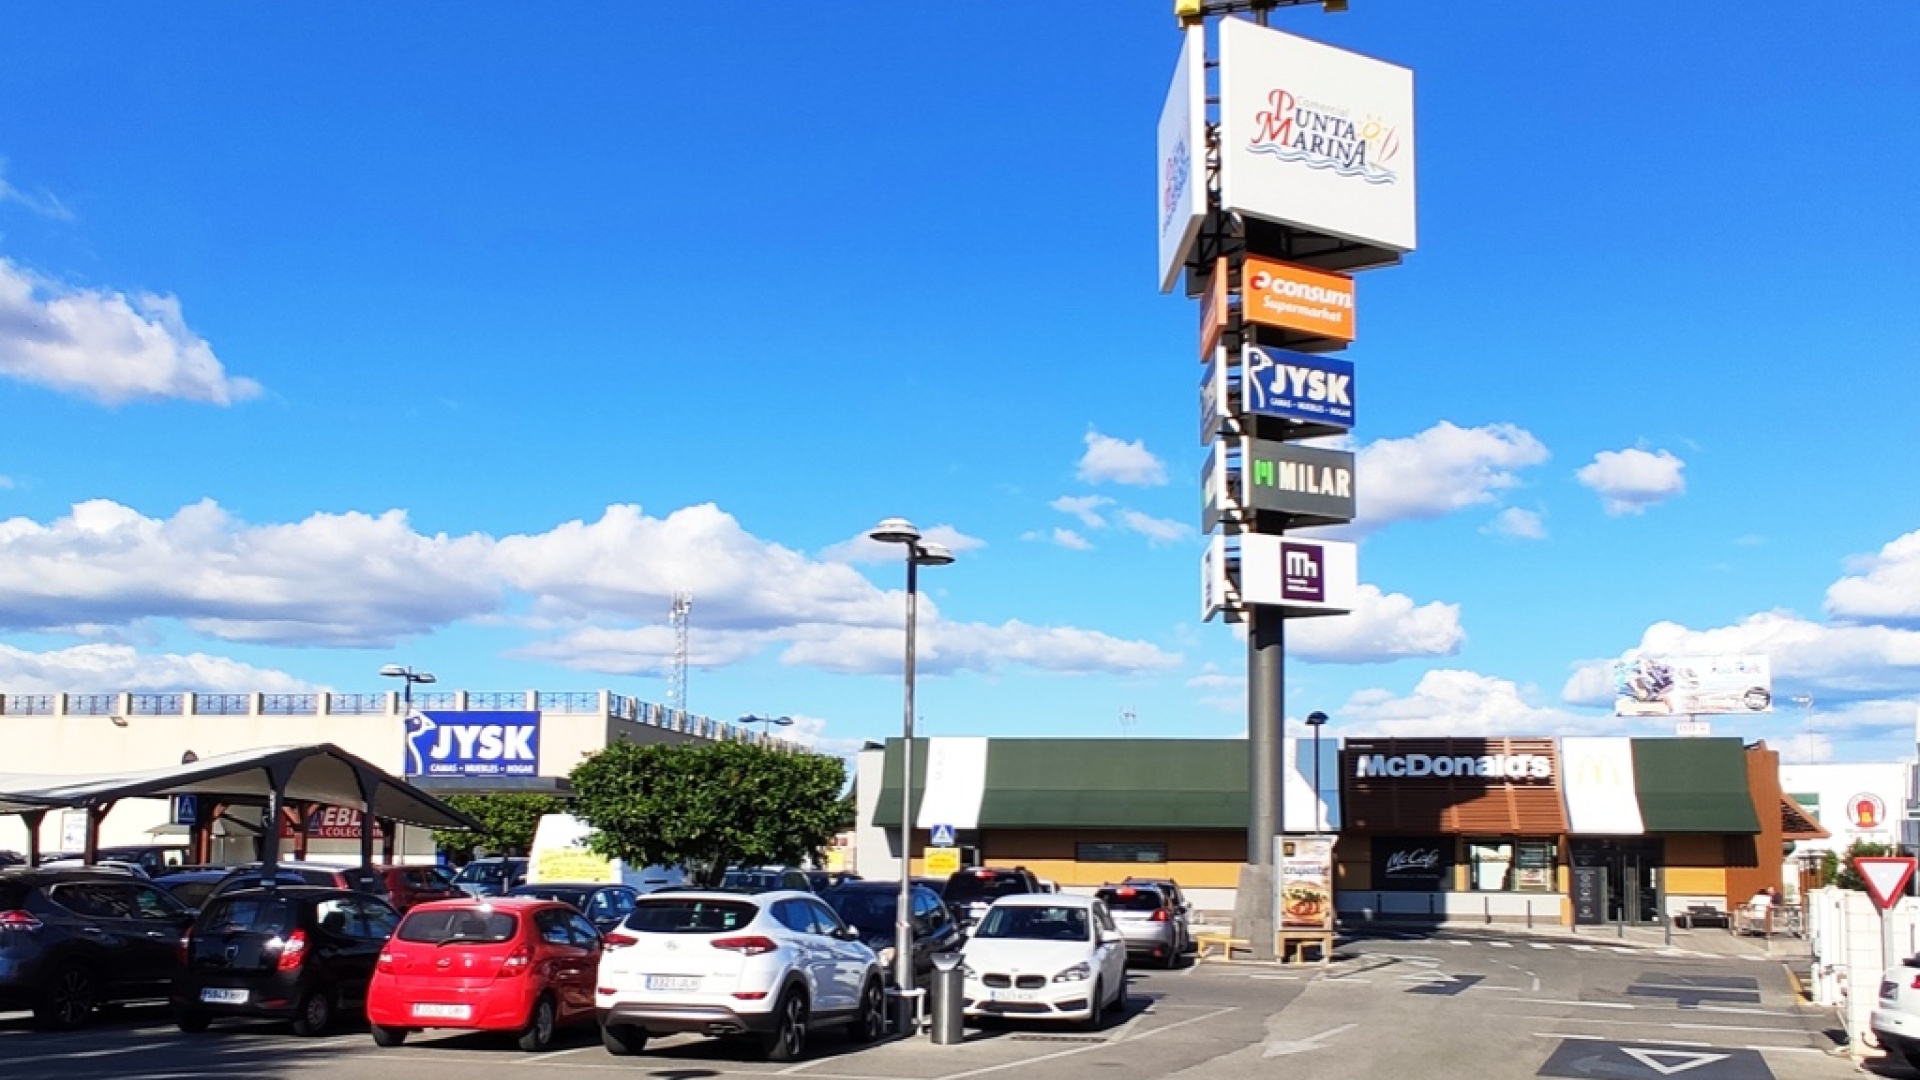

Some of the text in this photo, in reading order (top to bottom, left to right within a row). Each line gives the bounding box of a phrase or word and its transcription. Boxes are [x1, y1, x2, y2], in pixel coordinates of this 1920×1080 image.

[1268, 88, 1356, 141] PUNTA
[1250, 110, 1366, 168] MARINA
[1263, 294, 1342, 323] Supermarket
[1272, 278, 1352, 308] consum
[1269, 363, 1351, 406] JYSK
[1278, 461, 1351, 498] MILAR
[430, 724, 536, 760] JYSK
[1356, 752, 1552, 780] McDonald's
